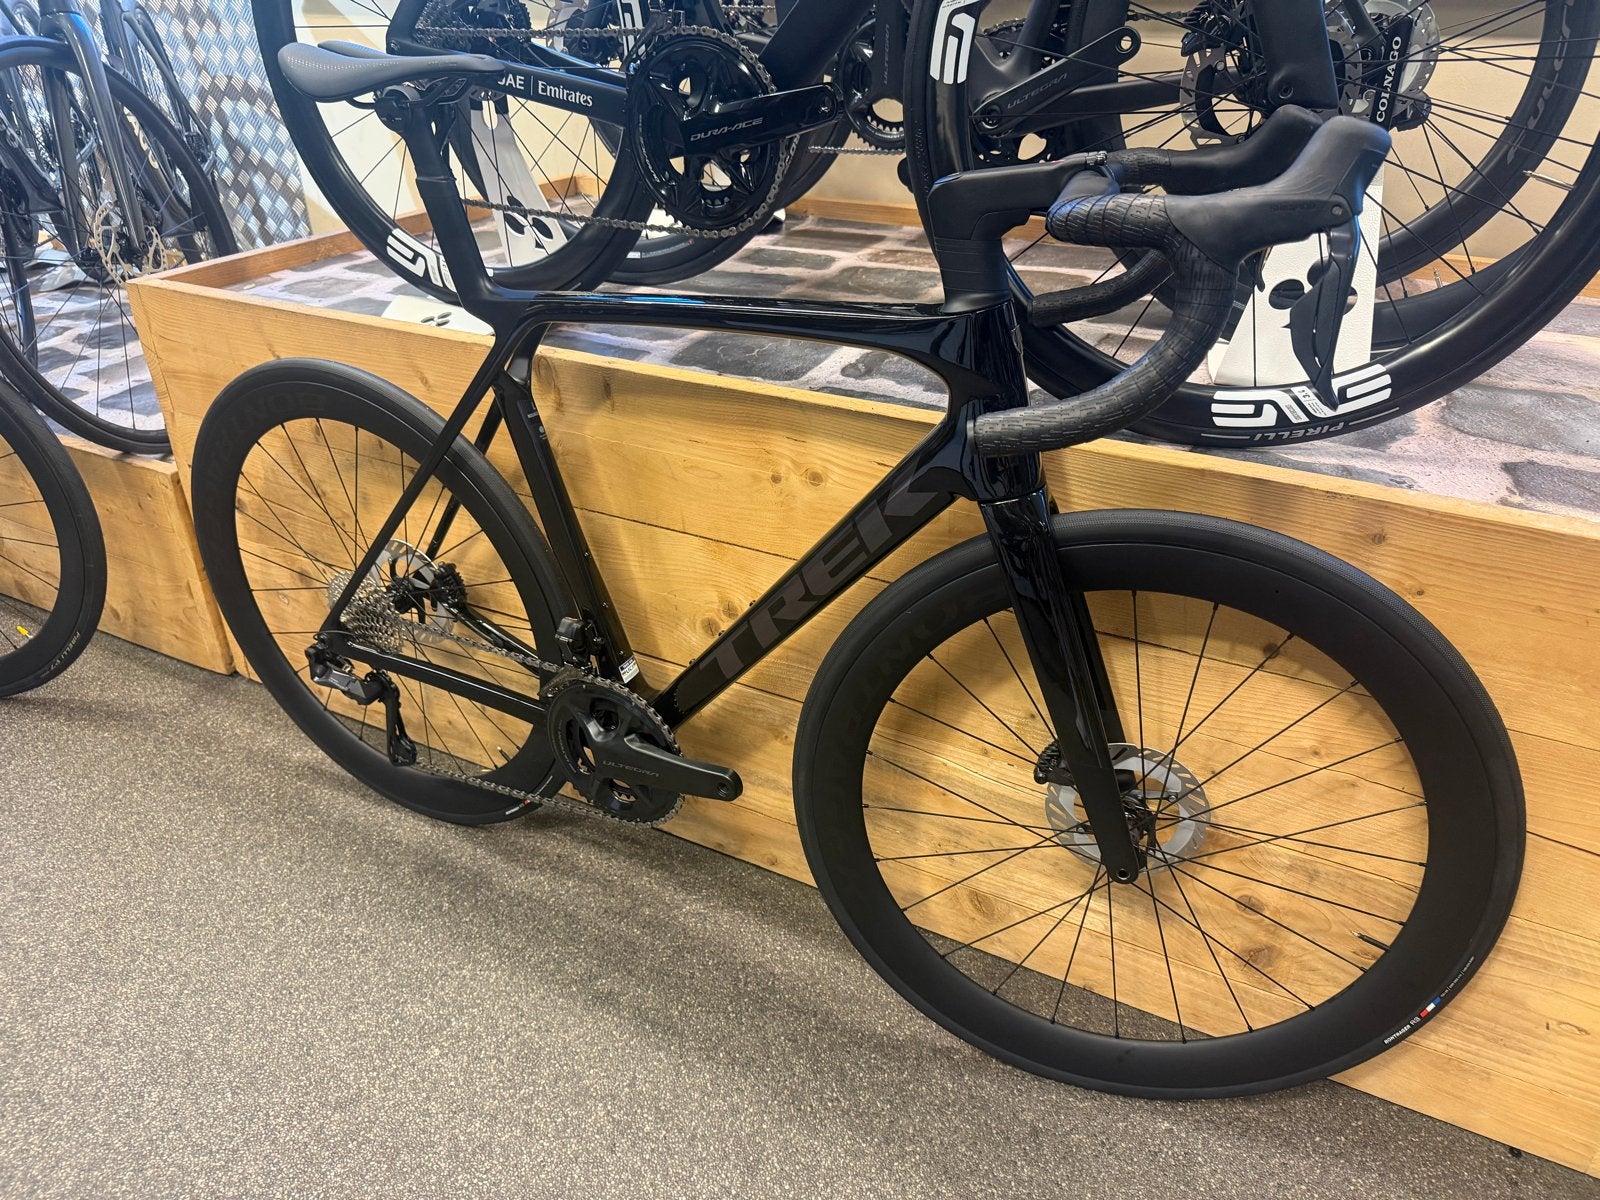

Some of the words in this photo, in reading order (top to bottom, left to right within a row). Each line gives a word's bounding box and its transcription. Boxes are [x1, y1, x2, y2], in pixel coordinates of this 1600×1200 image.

[1007, 72, 1068, 109] ULTEGRA
[1376, 36, 1402, 123] COLNAGO
[1506, 0, 1575, 165] FULCR
[538, 80, 593, 107] Emirates
[690, 117, 764, 142] DURA-ACE
[1253, 421, 1345, 441] PIRELLI
[698, 454, 939, 680] TREK
[61, 631, 80, 659] PIRELLI
[602, 760, 660, 778] ULTEGRA
[1383, 1024, 1411, 1044] BONTRAGER
